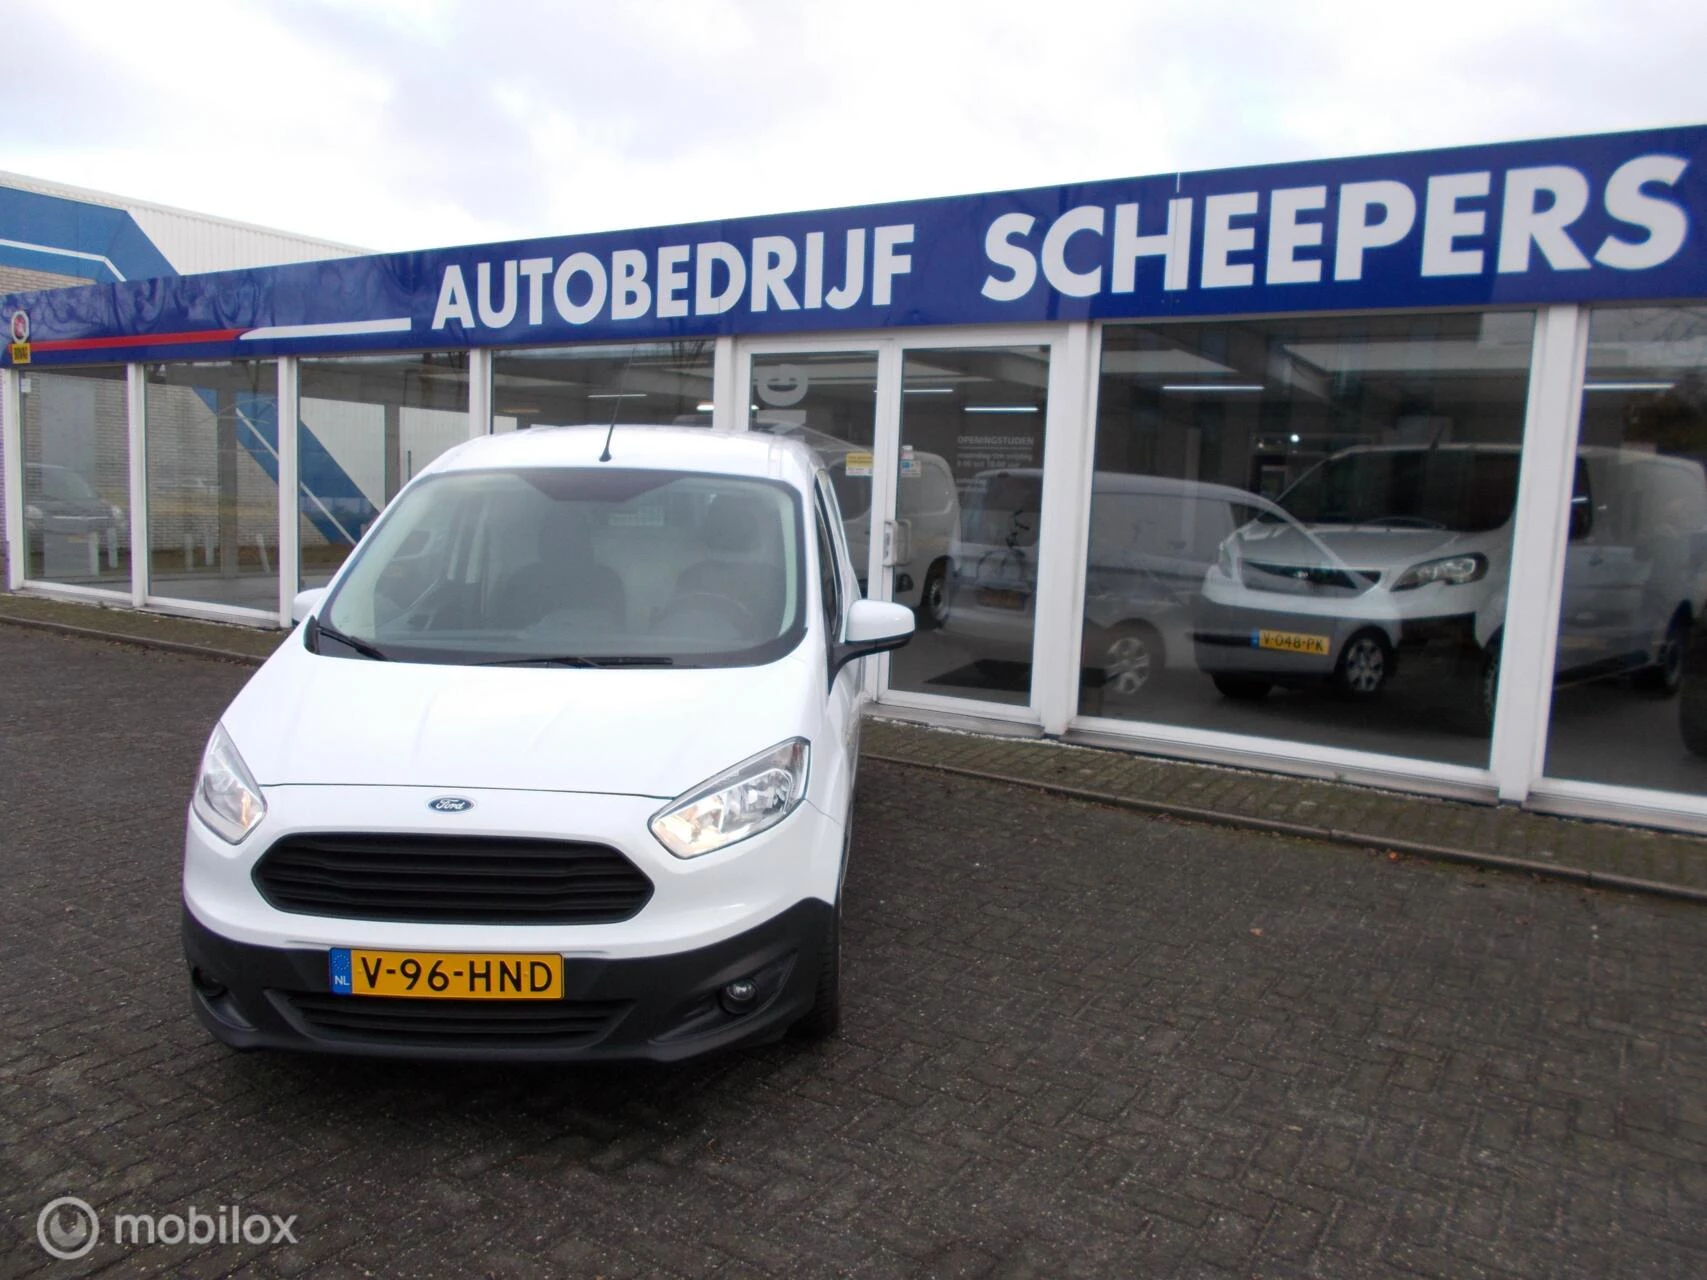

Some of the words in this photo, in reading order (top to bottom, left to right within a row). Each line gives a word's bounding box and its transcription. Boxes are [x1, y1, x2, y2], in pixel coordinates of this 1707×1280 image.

[431, 223, 915, 330] AUTOBEDRIJF
[980, 154, 1690, 302] SCHEEPERS
[435, 798, 466, 810] Ford
[334, 974, 351, 986] NL
[360, 956, 553, 993] V-96-HND
